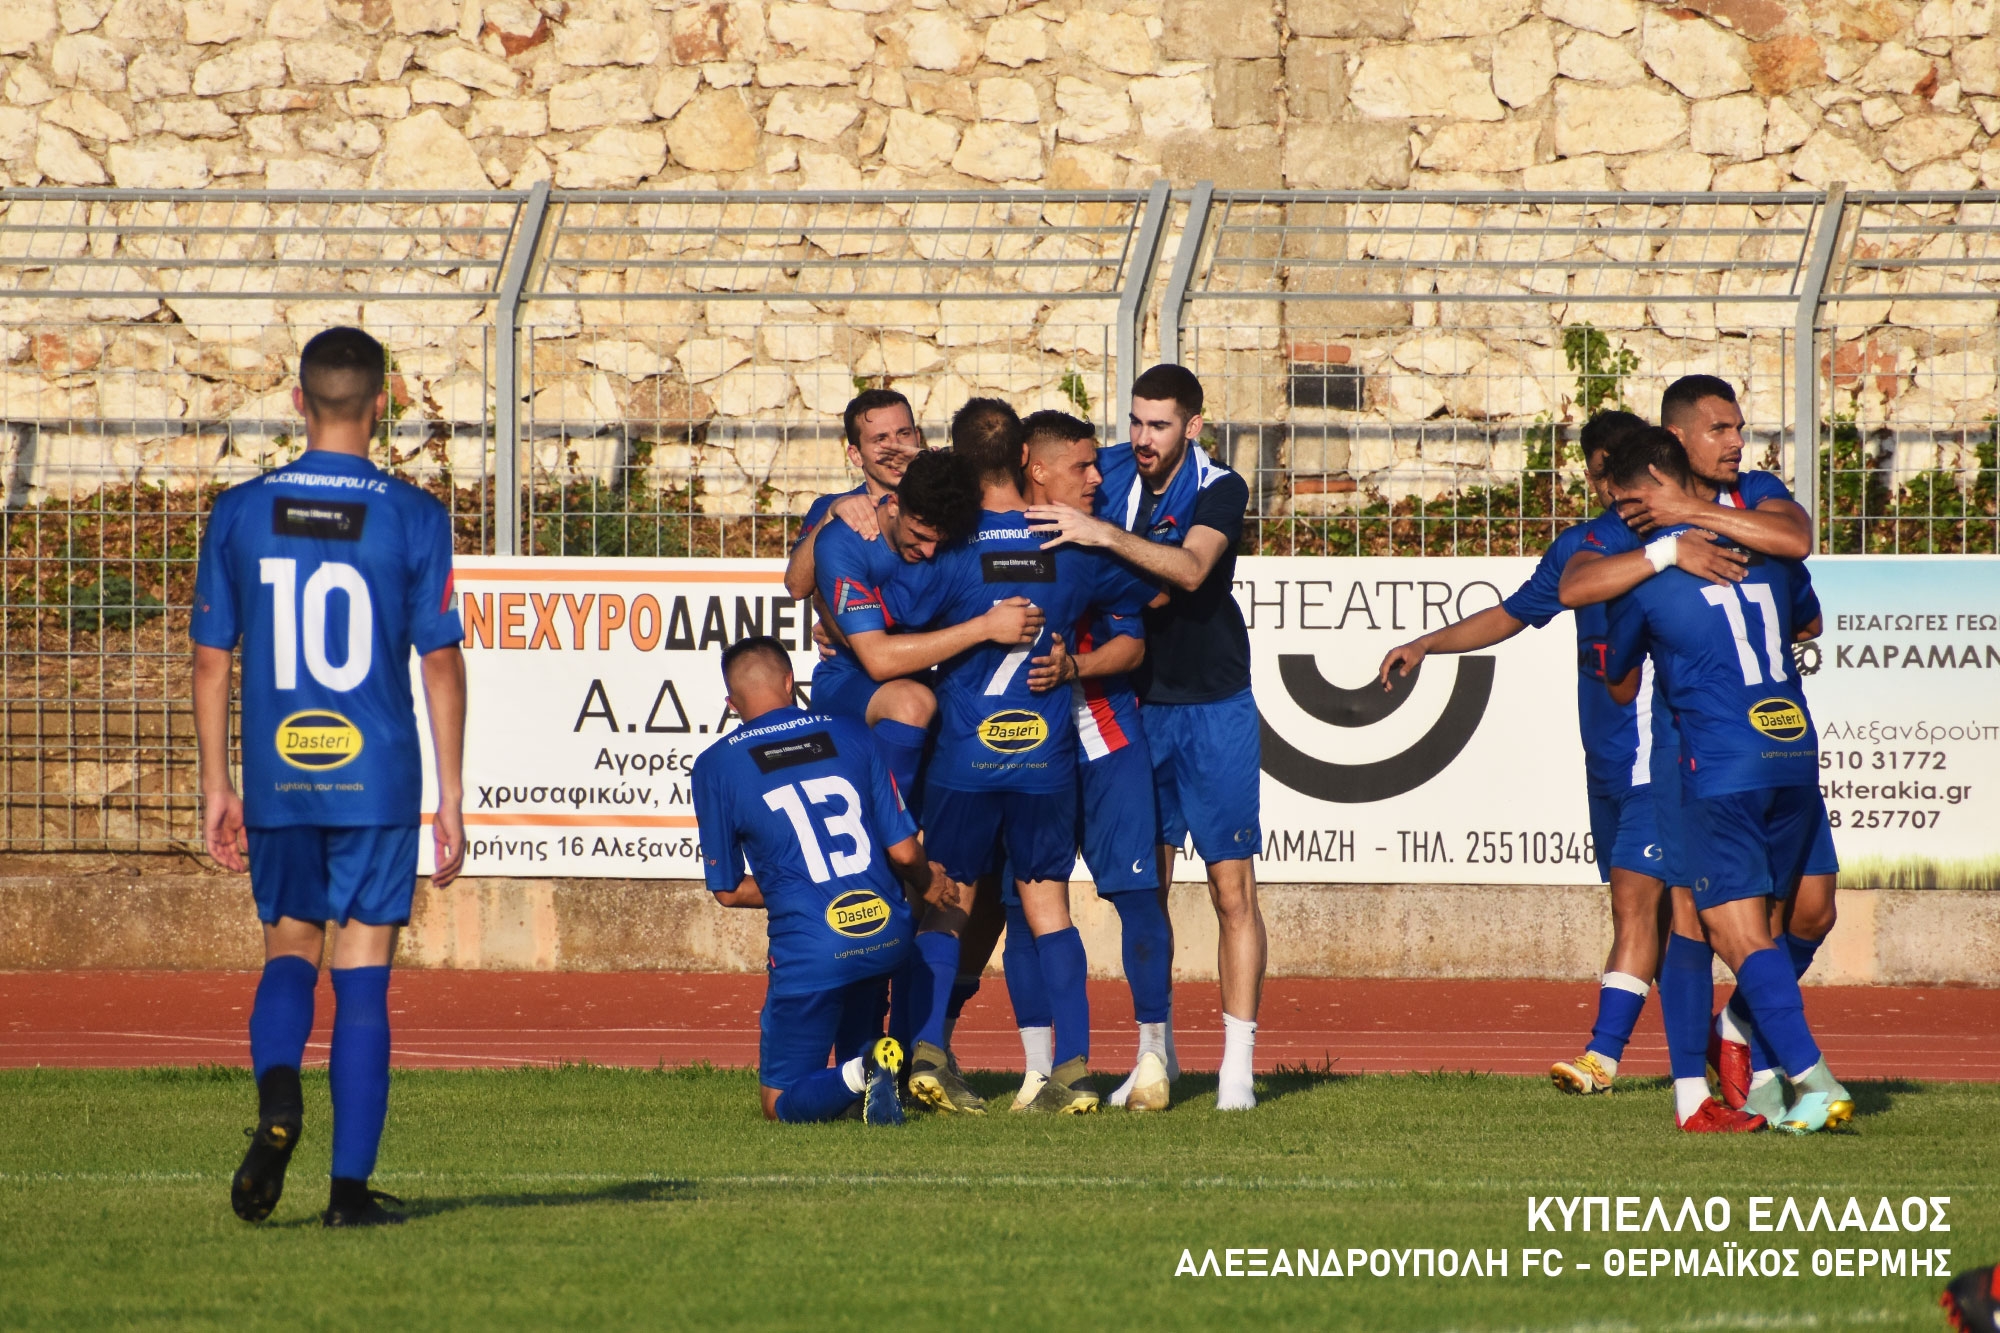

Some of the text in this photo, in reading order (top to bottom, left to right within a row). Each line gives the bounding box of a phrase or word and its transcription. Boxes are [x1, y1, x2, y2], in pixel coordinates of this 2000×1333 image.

[264, 472, 365, 489] ALEXANDROUPOLI
[259, 558, 373, 692] 10
[463, 592, 813, 652] ΝΕΧΥΡΟΔΑΝΕΙ
[1837, 614, 2000, 631] ΕΙΣΑΓΩΓΕΣ ΓΕΩ
[1700, 583, 1788, 687] 11
[984, 600, 1044, 696] 7
[1836, 644, 2000, 669] ΚΑΡΑΜΑΝ
[285, 731, 351, 749] Dasteri
[728, 716, 814, 745] ALEXANDROUPOLI
[986, 723, 1039, 738] Dasteri
[1822, 720, 2000, 745] Αλεξανδρούπ
[594, 747, 694, 776] Αγορές
[971, 761, 1004, 770] Lighting
[1006, 762, 1024, 770] your
[1871, 751, 1947, 770] 31772
[275, 781, 364, 792] Lighting your needs
[477, 781, 659, 809] χρυσαφικών,
[762, 775, 872, 884] 13
[1850, 809, 1941, 829] 257707
[466, 835, 548, 861] ιρήνης
[556, 836, 584, 857] 16
[1256, 829, 1355, 862] ΛΜΑΖΗ
[1397, 830, 1454, 864] ΤΗΛ.
[1466, 830, 1597, 864] 25510348
[836, 901, 883, 924] Dasteri
[834, 947, 865, 959] Lighting
[865, 944, 881, 954] your
